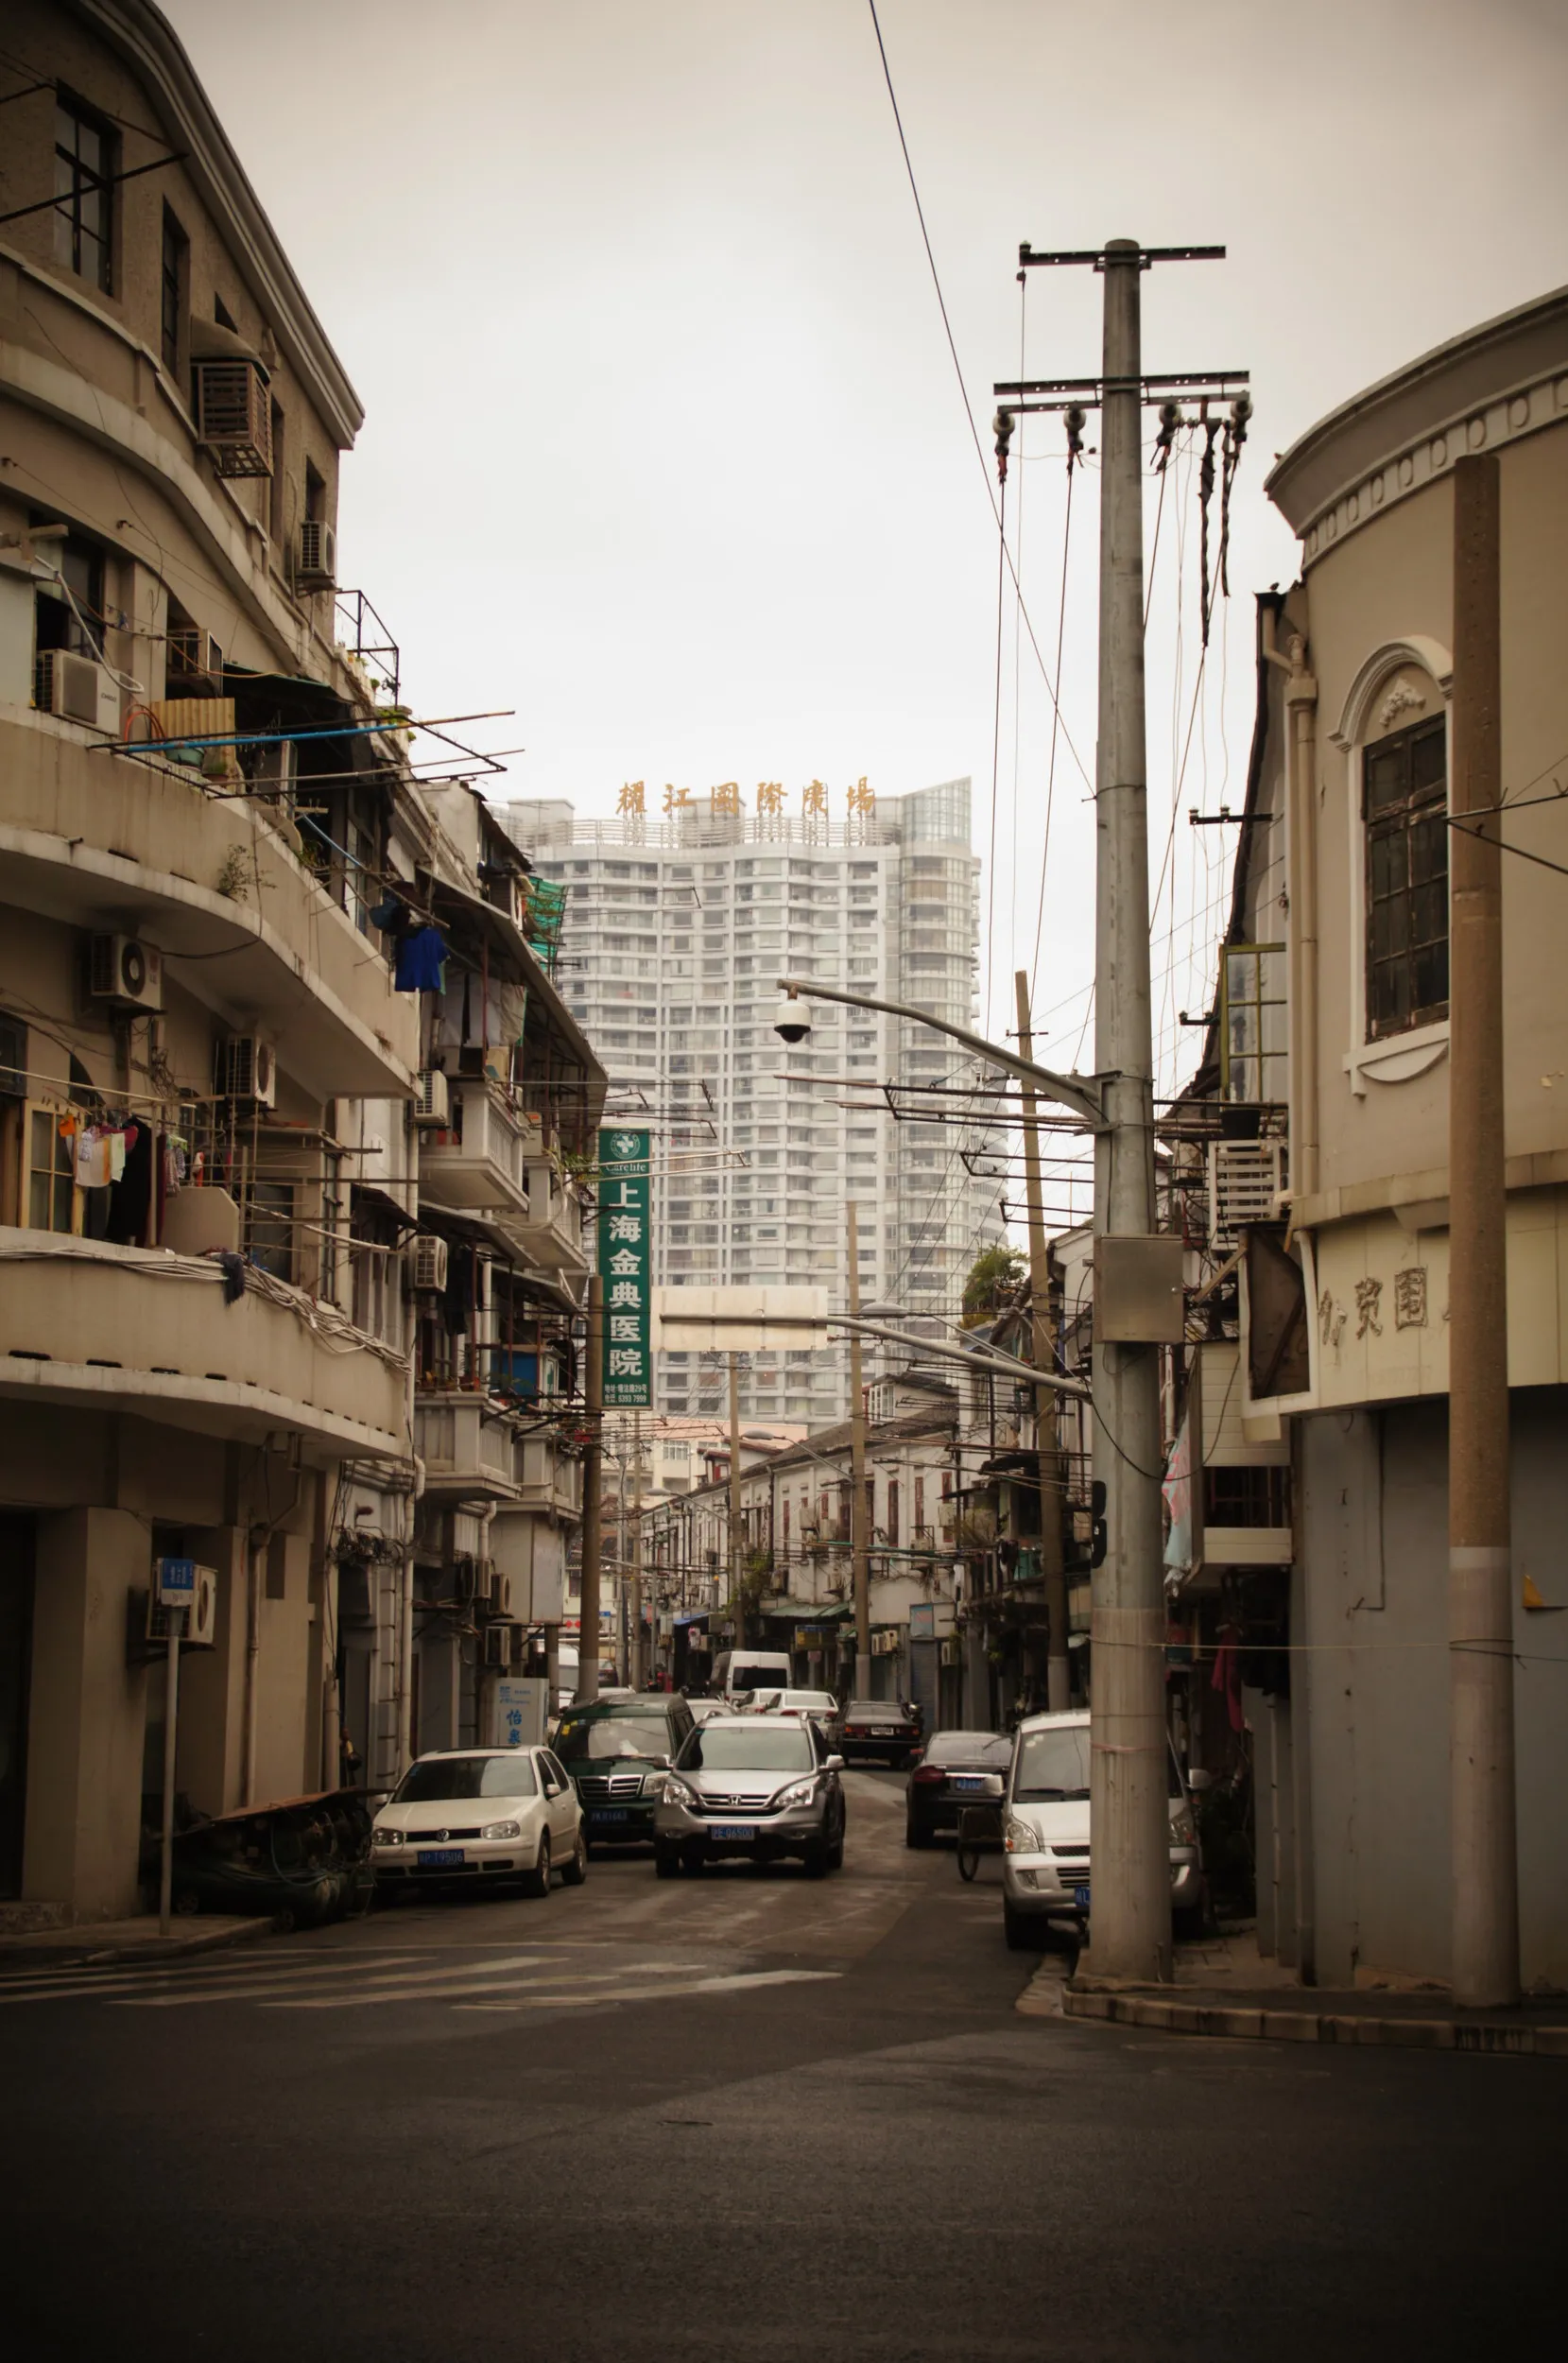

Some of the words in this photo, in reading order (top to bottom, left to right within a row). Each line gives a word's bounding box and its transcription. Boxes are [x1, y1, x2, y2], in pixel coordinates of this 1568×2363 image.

[609, 1182, 643, 1376] 上海金典医院
